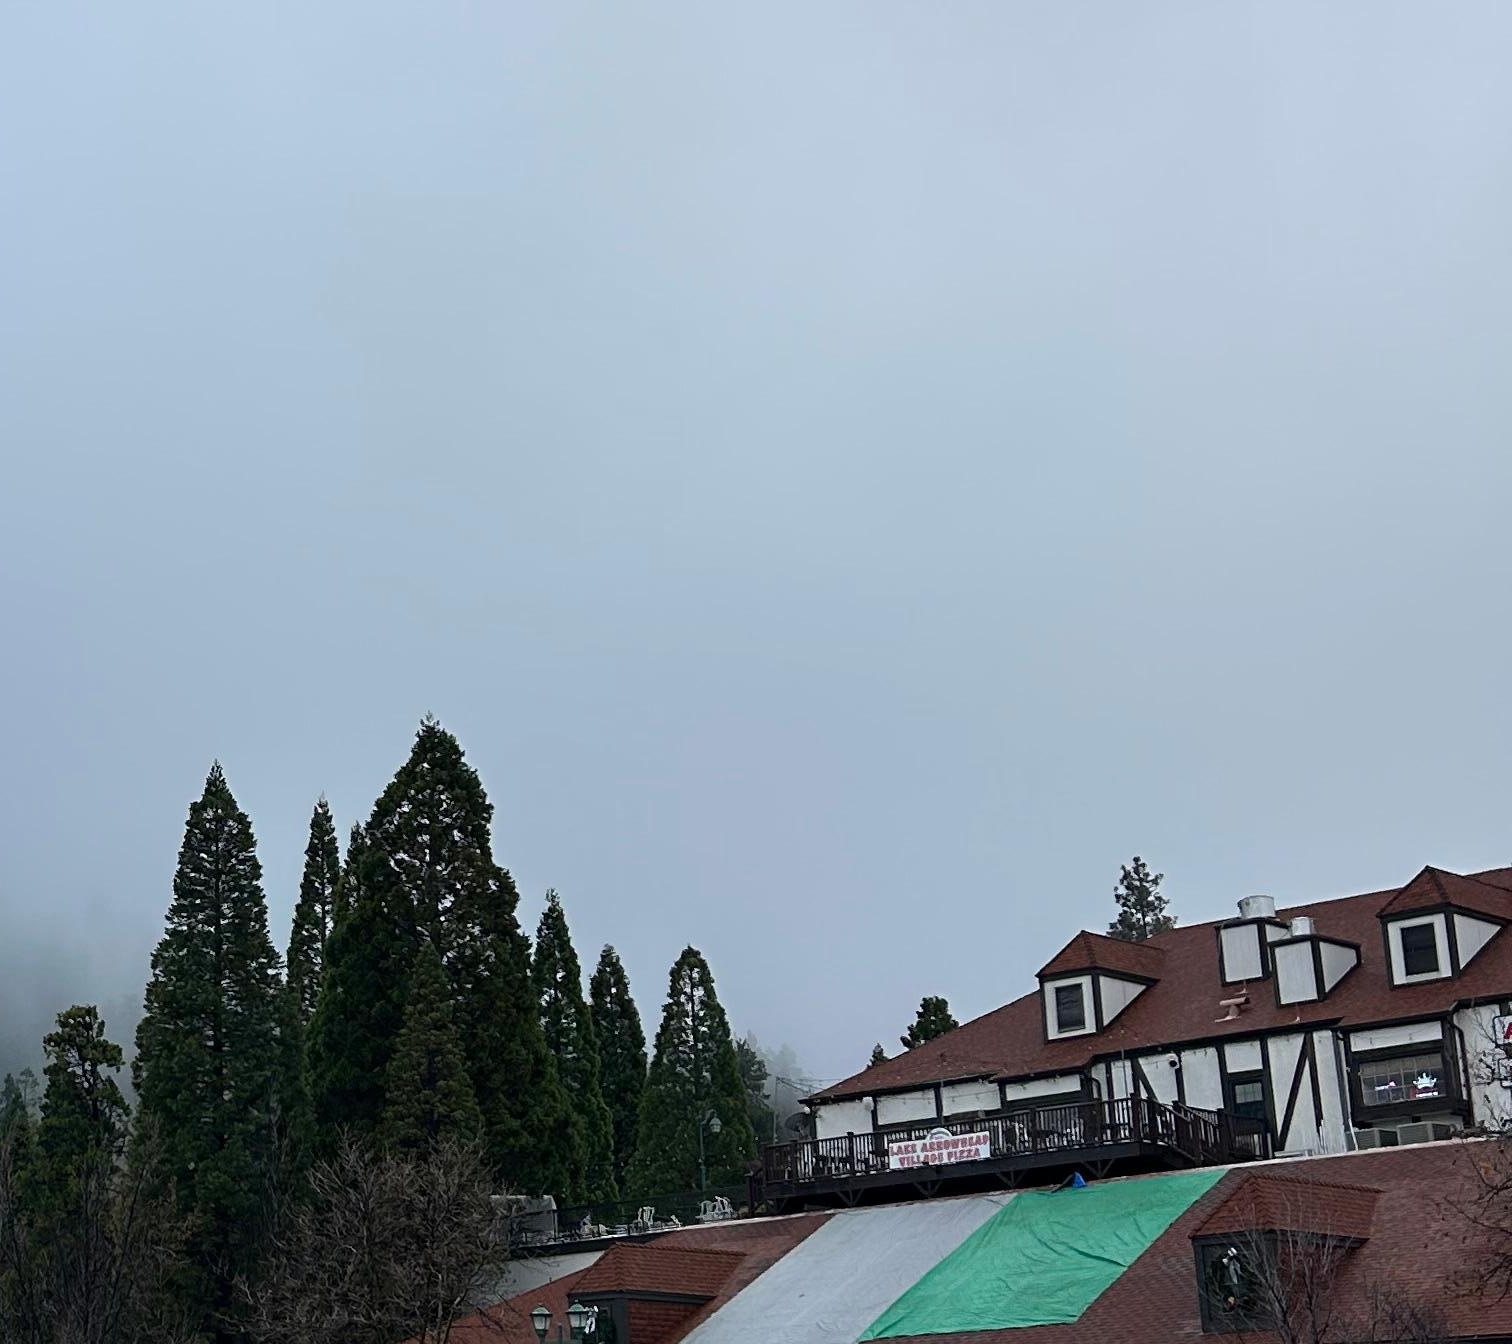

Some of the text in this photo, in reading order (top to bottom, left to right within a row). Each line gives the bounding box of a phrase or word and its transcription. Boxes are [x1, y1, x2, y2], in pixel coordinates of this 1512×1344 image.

[889, 1134, 988, 1156] LAKE ARROWHEAD
[899, 1147, 981, 1167] VILLAGE PIZZA
